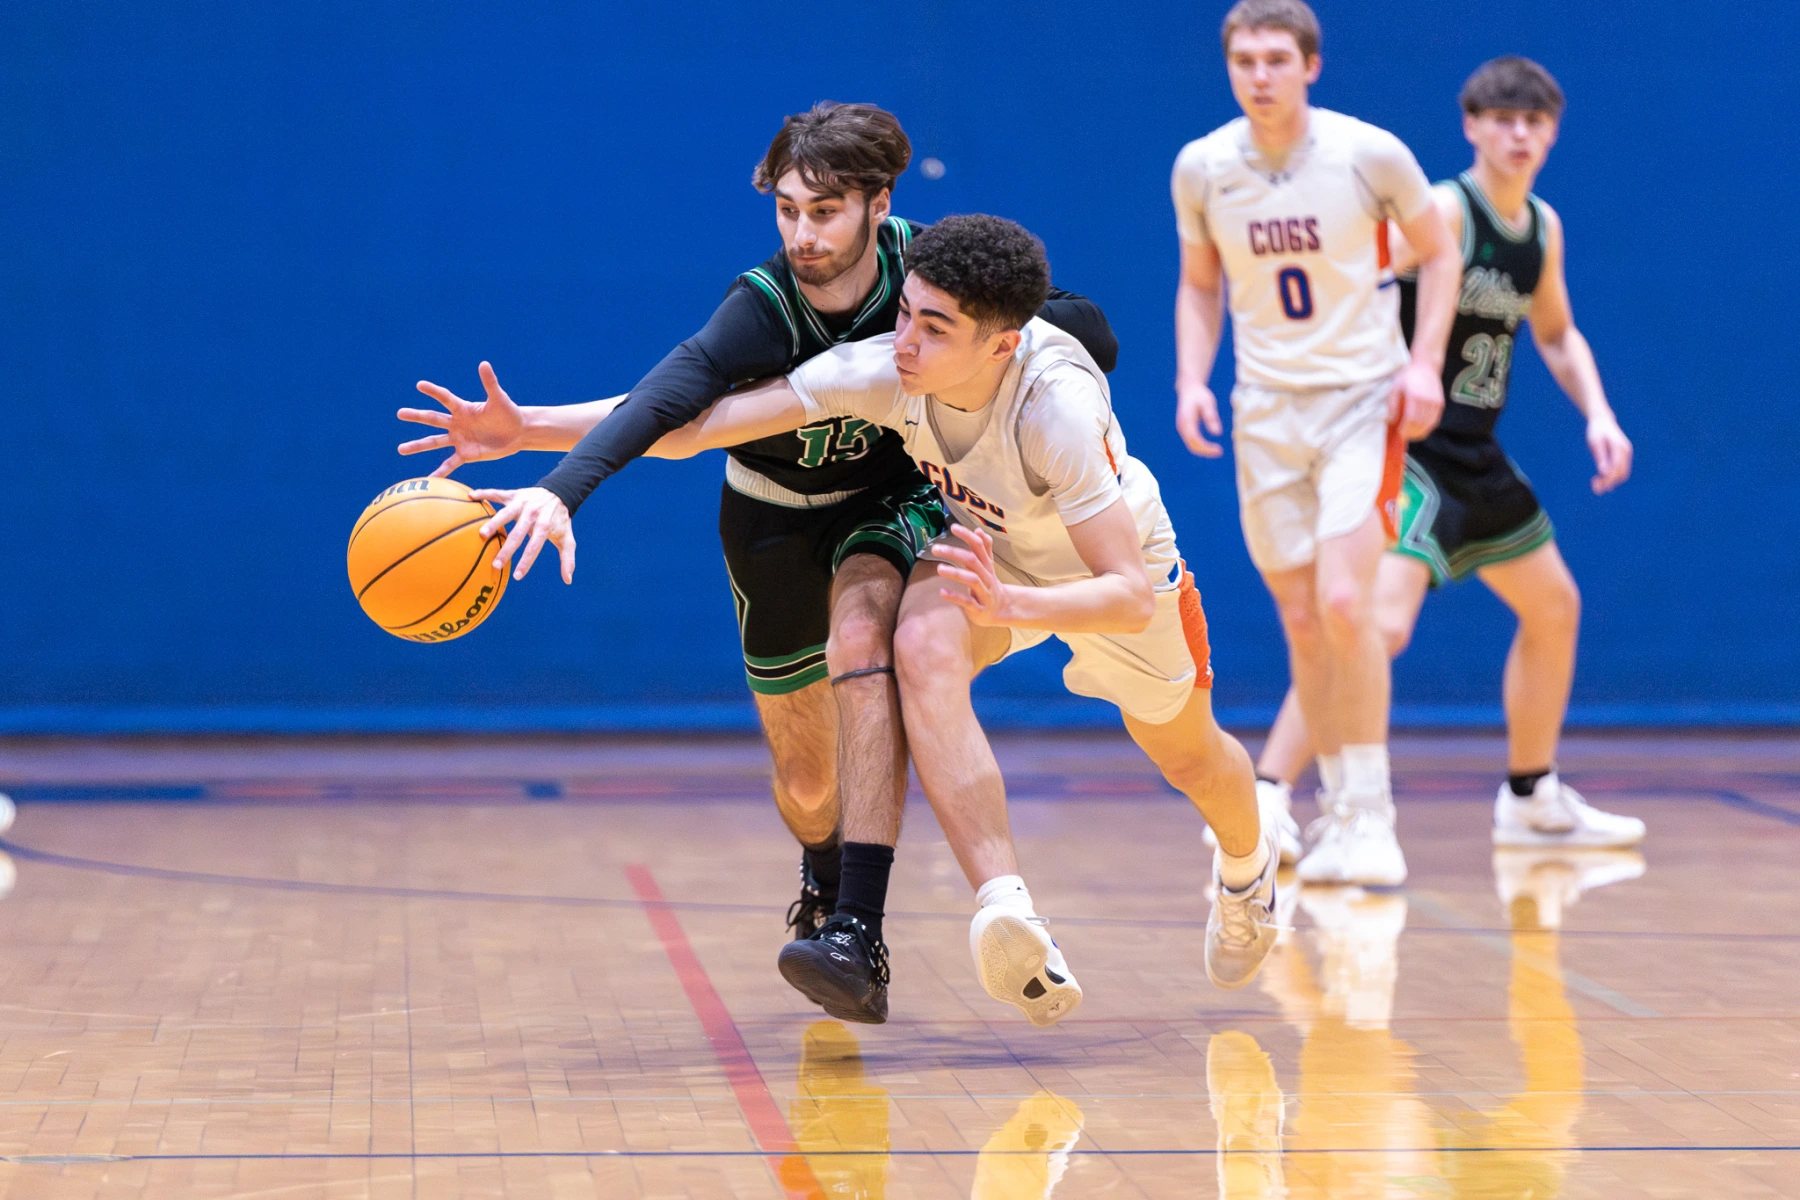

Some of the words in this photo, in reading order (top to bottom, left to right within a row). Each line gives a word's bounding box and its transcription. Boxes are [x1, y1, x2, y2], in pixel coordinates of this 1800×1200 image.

[1249, 218, 1320, 255] COGS
[1278, 266, 1313, 320] 0
[797, 417, 883, 468] 15
